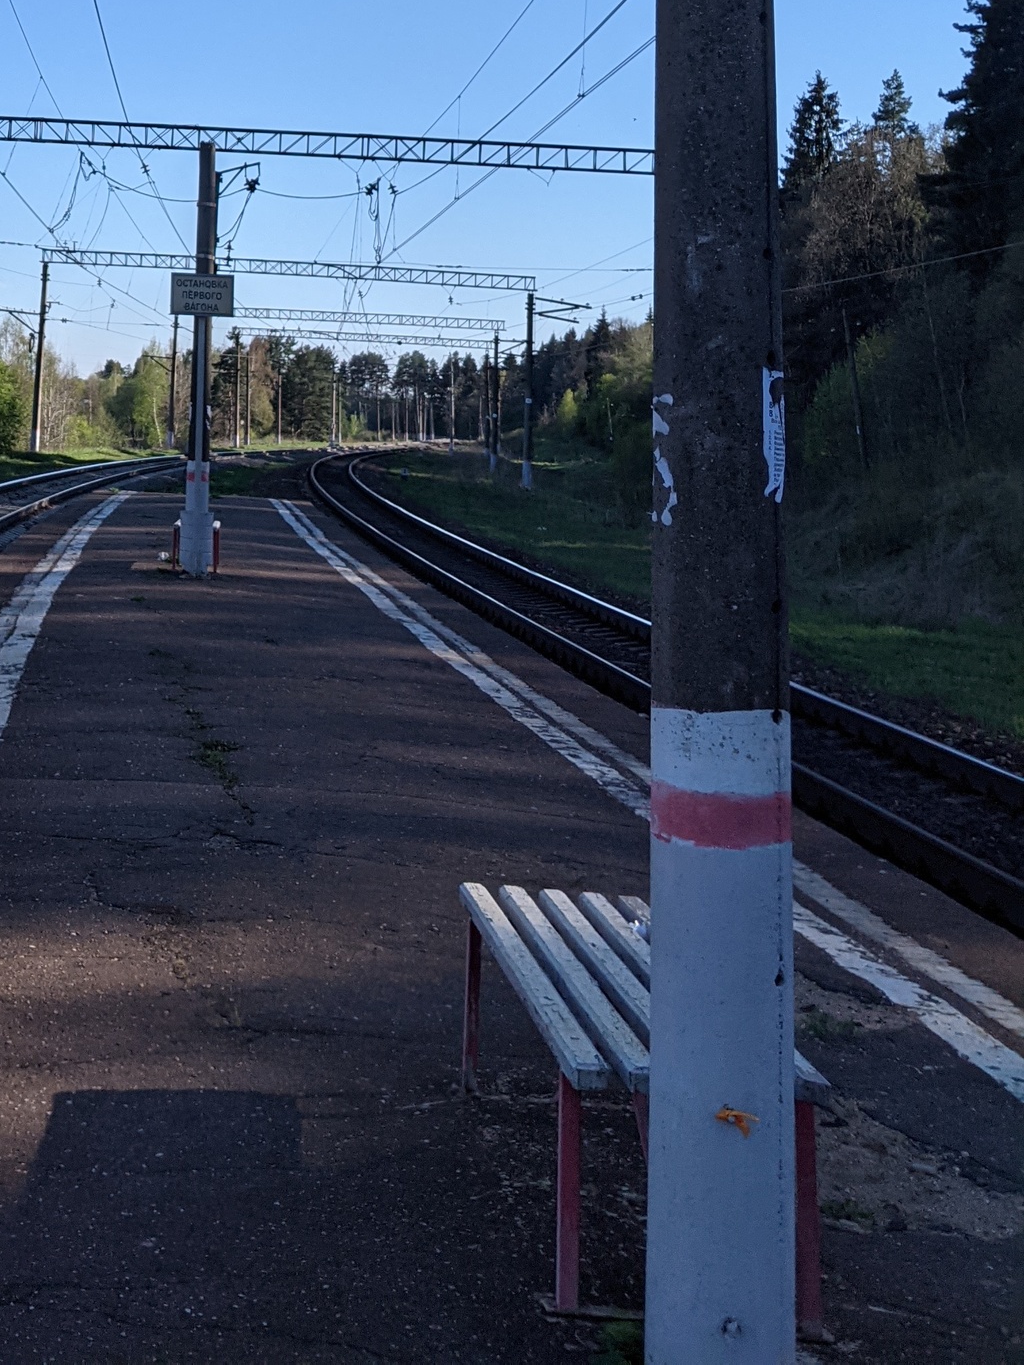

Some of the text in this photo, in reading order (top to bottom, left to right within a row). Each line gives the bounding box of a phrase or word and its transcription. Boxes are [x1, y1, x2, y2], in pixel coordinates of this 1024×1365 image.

[176, 279, 228, 289] ОСТАНОВКА
[182, 290, 222, 300] ПЕРВОГО
[184, 302, 219, 311] ВАГОНА
